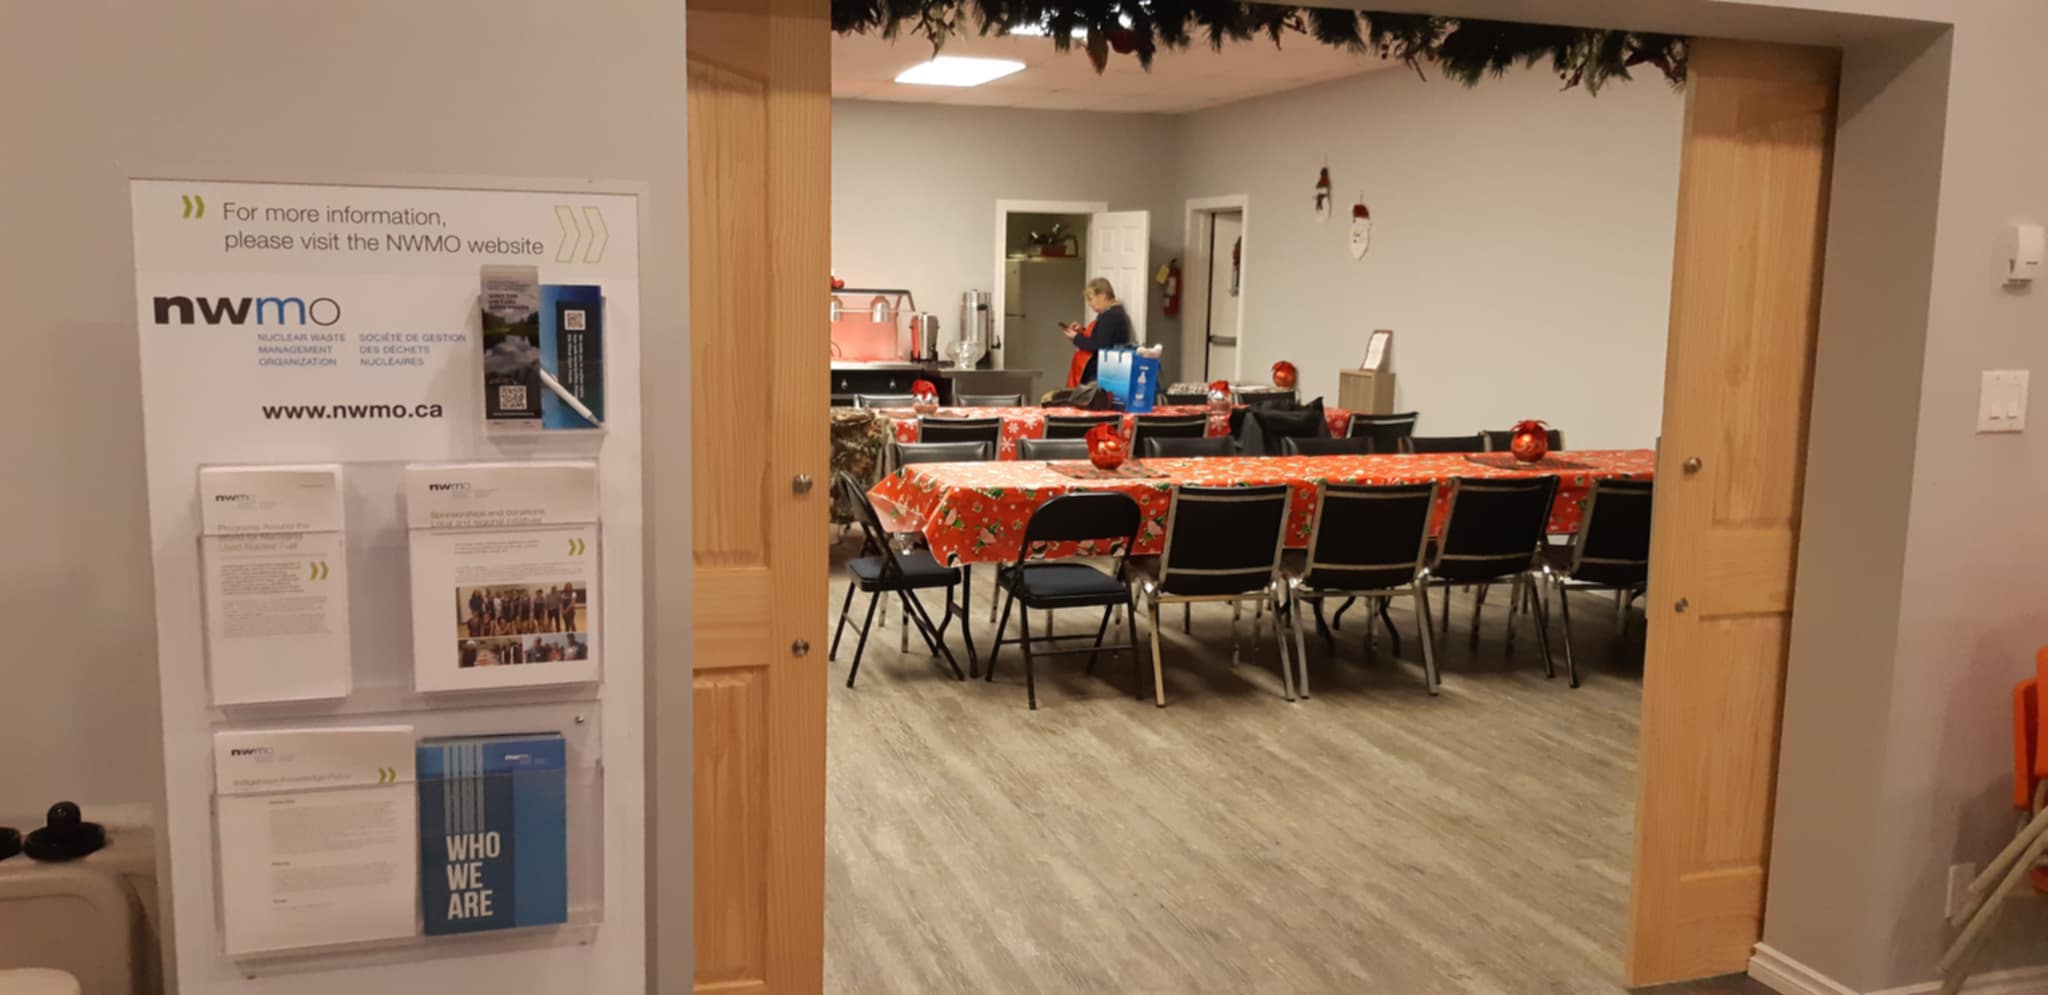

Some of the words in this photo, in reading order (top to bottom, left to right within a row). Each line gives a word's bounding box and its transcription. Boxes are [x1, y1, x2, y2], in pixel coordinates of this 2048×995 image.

[223, 202, 259, 221] For
[265, 207, 320, 223] more
[326, 205, 446, 228] information,
[225, 230, 294, 252] please
[301, 231, 340, 251] visit
[347, 232, 380, 251] the
[386, 233, 461, 253] NWMO
[467, 236, 544, 256] website
[153, 296, 341, 327] nwmo
[257, 333, 308, 343] NUCLEAR
[310, 333, 345, 343] WASTE
[359, 332, 401, 343] SOCIÉTÉ
[404, 333, 419, 343] DE
[422, 333, 467, 343] GESTION
[258, 345, 333, 355] MANAGEMENT
[359, 345, 381, 355] DES
[383, 344, 431, 355] DÉCHETS
[258, 357, 337, 367] ORGANIZATION
[359, 356, 425, 367] NUCLÉAIRES
[262, 401, 444, 420] www.nwmo.ca
[446, 831, 501, 861] WHO
[446, 862, 483, 891] WE
[447, 890, 494, 920] ARE
